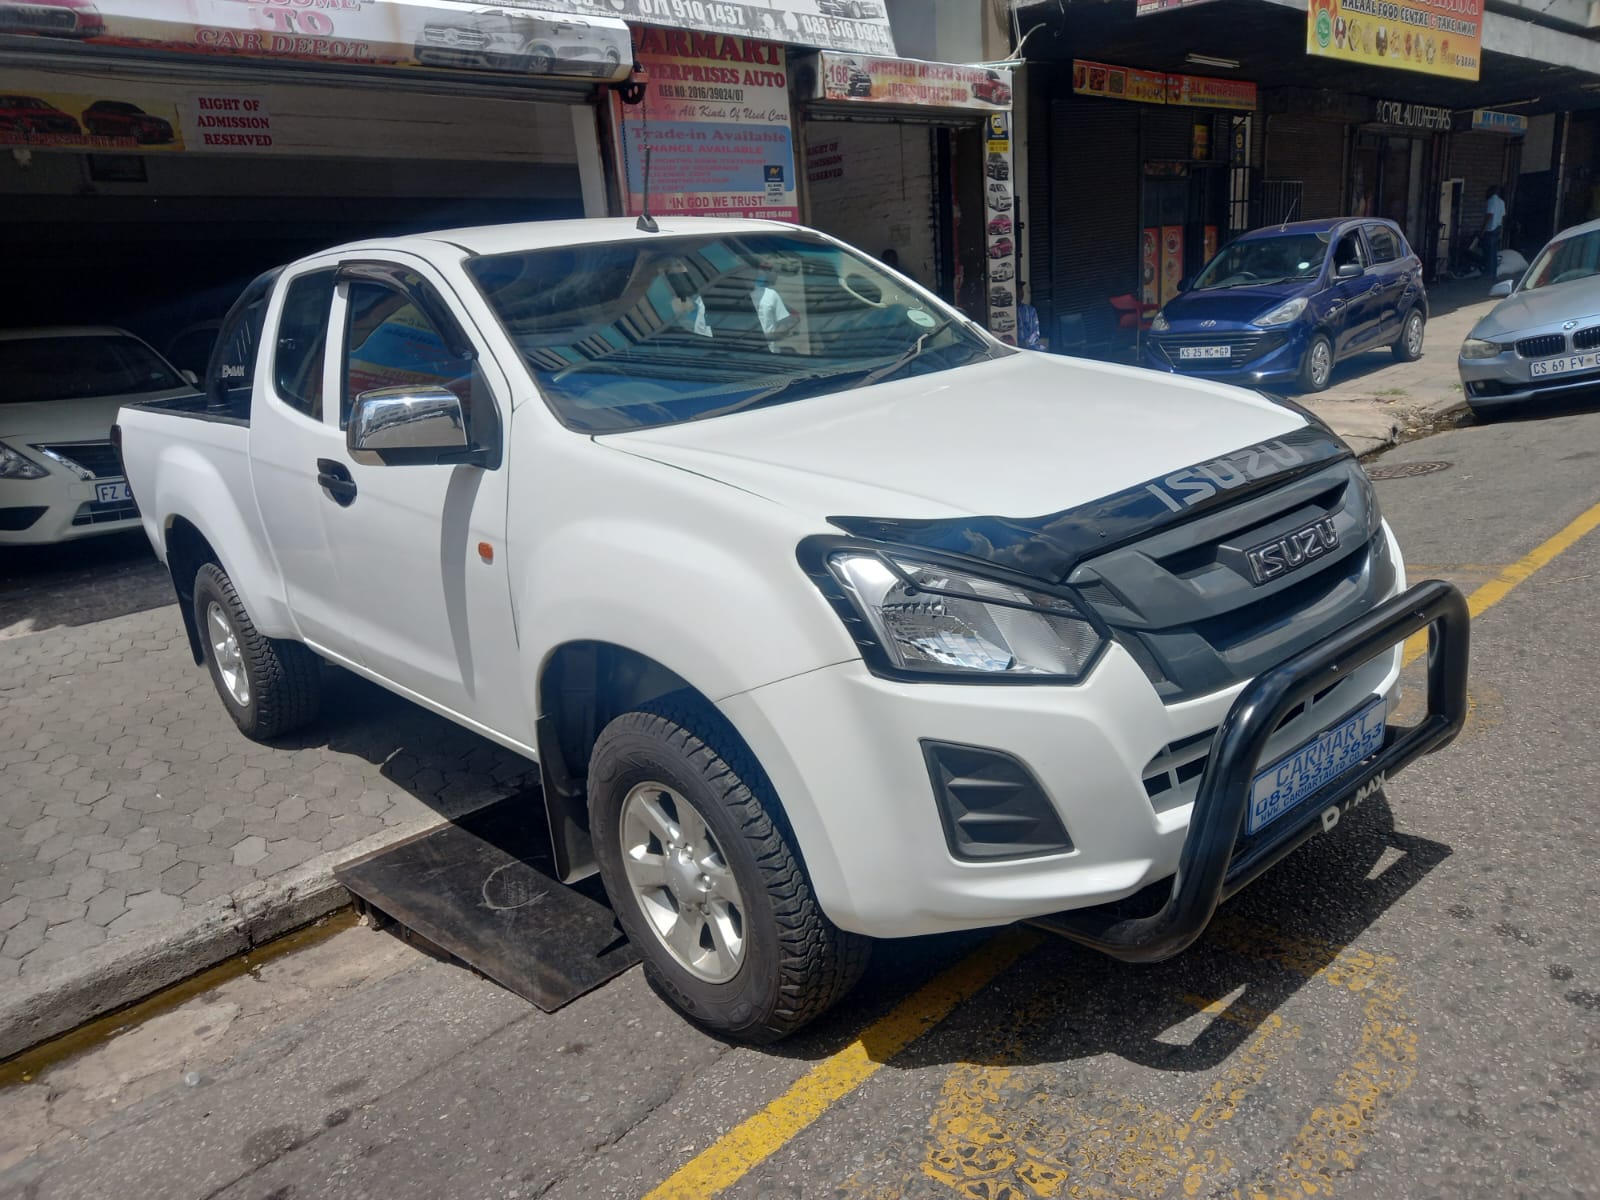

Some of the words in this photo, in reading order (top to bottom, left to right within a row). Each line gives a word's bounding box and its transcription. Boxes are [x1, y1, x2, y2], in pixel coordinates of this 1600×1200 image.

[263, 6, 333, 36] TO
[708, 3, 746, 26] 1437
[1377, 6, 1399, 21] FOOD
[1400, 8, 1429, 27] CENTRE
[1437, 15, 1456, 32] TAKE
[1456, 20, 1478, 38] AWAY
[801, 15, 828, 35] 083
[196, 28, 262, 50] CAR
[272, 35, 368, 58] DEPOT
[743, 68, 786, 89] AUTO
[829, 64, 849, 84] 168
[198, 97, 240, 111] RIGHT
[243, 99, 260, 112] OF
[679, 104, 696, 118] All
[698, 105, 726, 118] Kinds
[730, 107, 742, 121] Of
[743, 108, 766, 120] Used
[767, 110, 788, 122] Cars
[198, 115, 270, 129] ADMISSION
[203, 133, 273, 146] RESERVED
[632, 127, 706, 141] Trade-in
[712, 128, 787, 142] Available
[698, 144, 764, 154] AVAILABLE
[688, 197, 710, 208] GOD
[712, 197, 728, 207] WE
[1533, 362, 1547, 374] CS
[1552, 360, 1565, 372] 69
[1570, 356, 1584, 369] FY
[1145, 440, 1304, 513] ISUZU
[101, 486, 118, 501] FZ
[1249, 518, 1339, 584] ISUZU
[1276, 713, 1370, 788] CARMART
[1256, 781, 1293, 817] 083
[1299, 754, 1334, 788] 533
[1339, 722, 1382, 760] 3653
